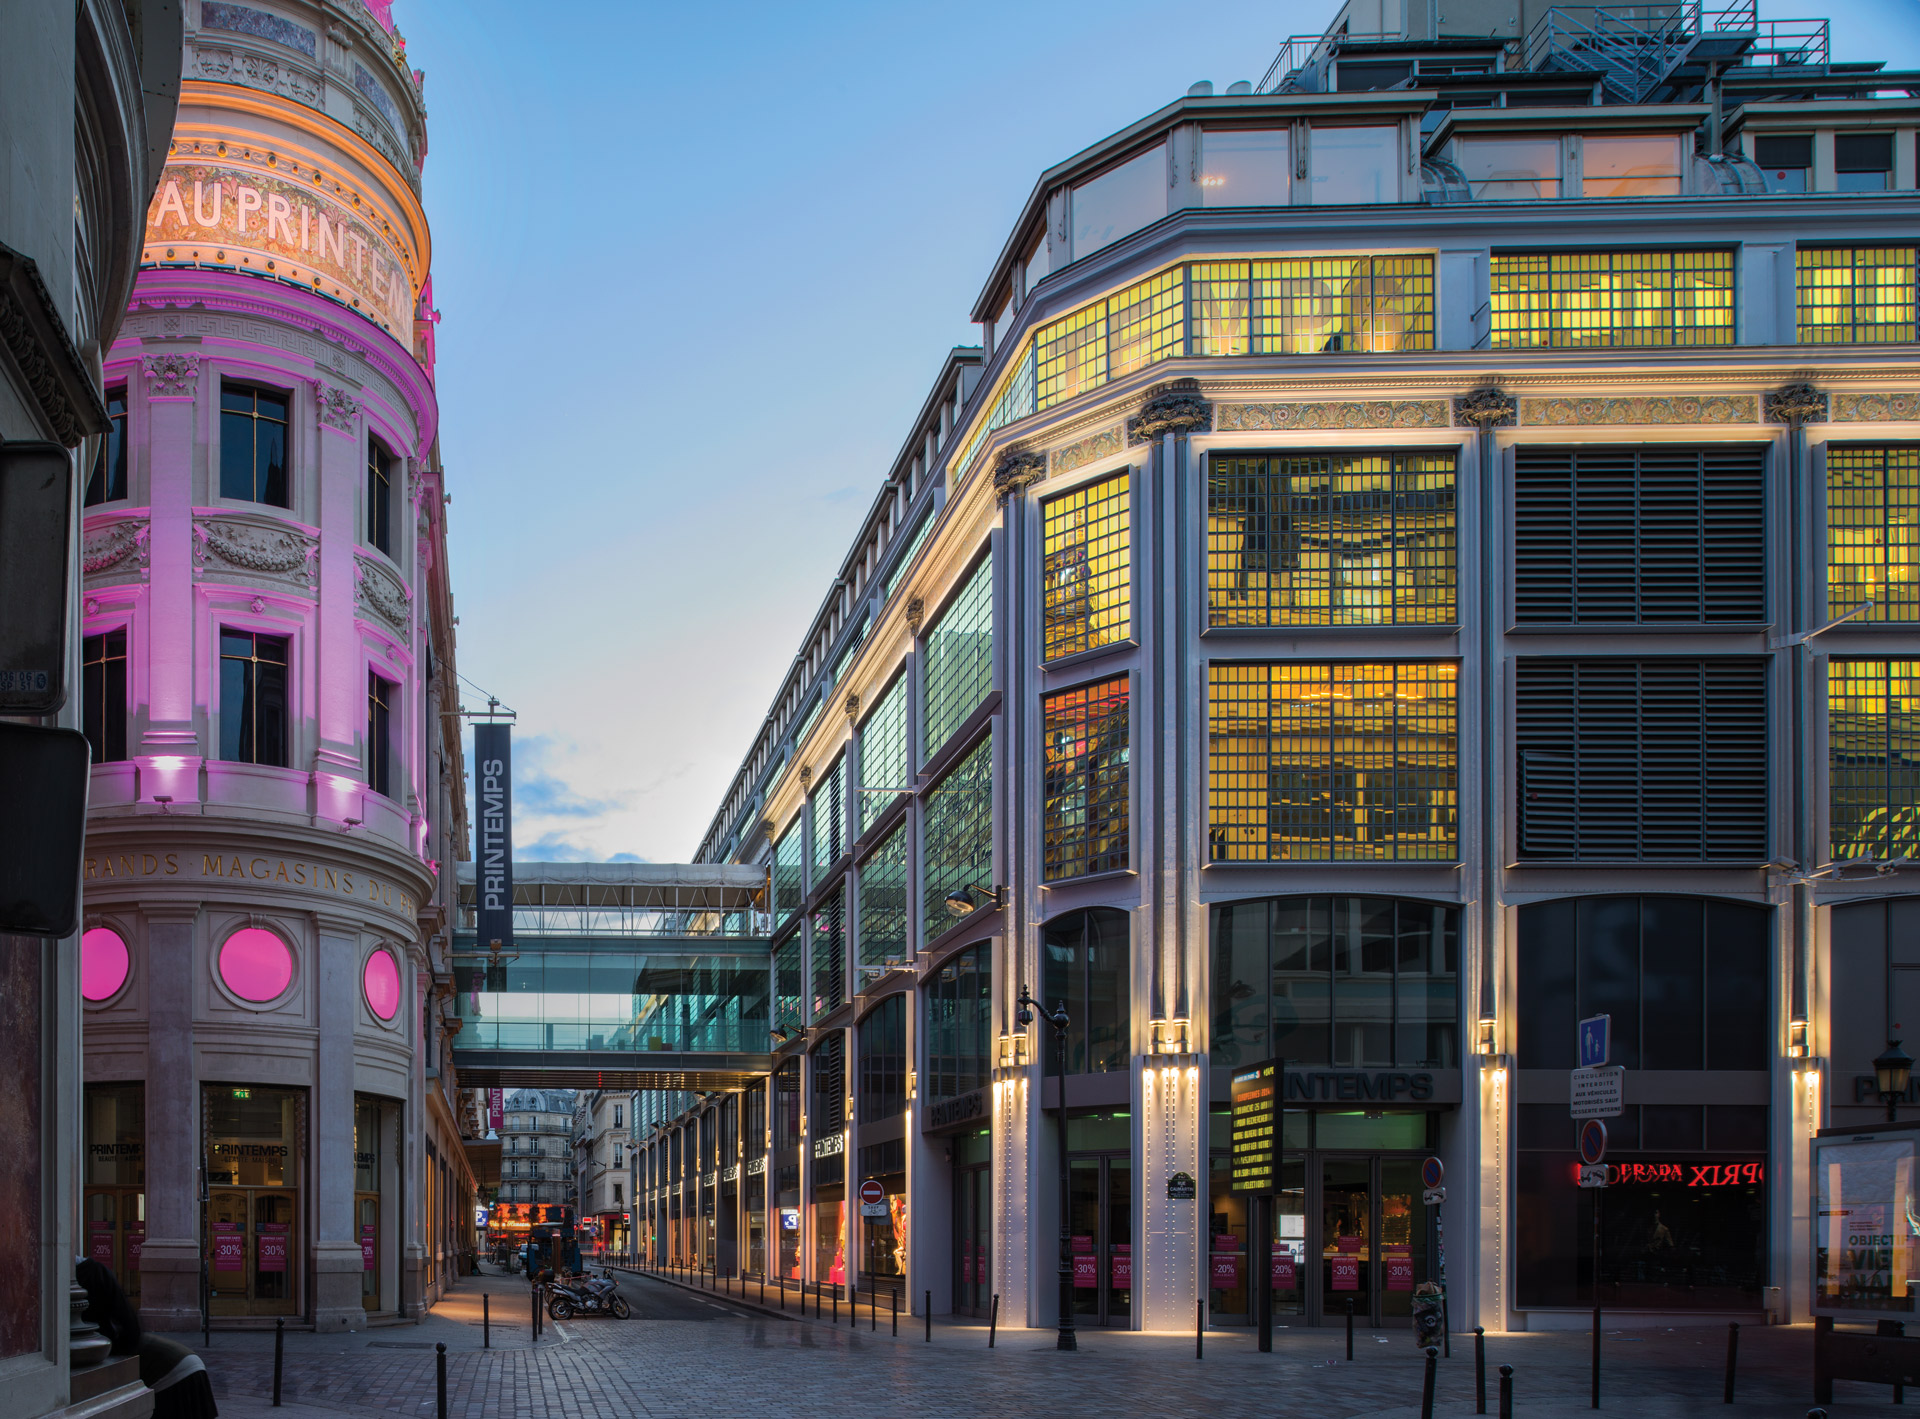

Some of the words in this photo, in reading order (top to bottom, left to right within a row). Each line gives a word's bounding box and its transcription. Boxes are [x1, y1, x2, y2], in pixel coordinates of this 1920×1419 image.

[154, 181, 223, 228] AU
[238, 186, 410, 336] PRINTEM
[0, 672, 14, 681] 36
[484, 759, 504, 911] PRINTEMPS
[202, 854, 354, 894] MAGASINS
[369, 880, 391, 906] DU
[1573, 1072, 1618, 1080] CIRCULATION
[1587, 1089, 1617, 1097] VÉHICULES
[931, 1093, 983, 1127] PRINTEMPS
[89, 1144, 144, 1155] PRINTEMP
[212, 1144, 288, 1157] PRINTEMPS
[1620, 1163, 1683, 1177] PRADA
[1849, 1234, 1910, 1246] OBJECTIF
[216, 1244, 241, 1256] -30%
[261, 1245, 285, 1256] -30%
[1847, 1249, 1906, 1271] VIET
[1074, 1263, 1096, 1274] -30%
[1214, 1264, 1235, 1274] -20%
[1272, 1264, 1292, 1274] -20%
[1333, 1265, 1357, 1276] -30%
[1388, 1265, 1412, 1276] -30%
